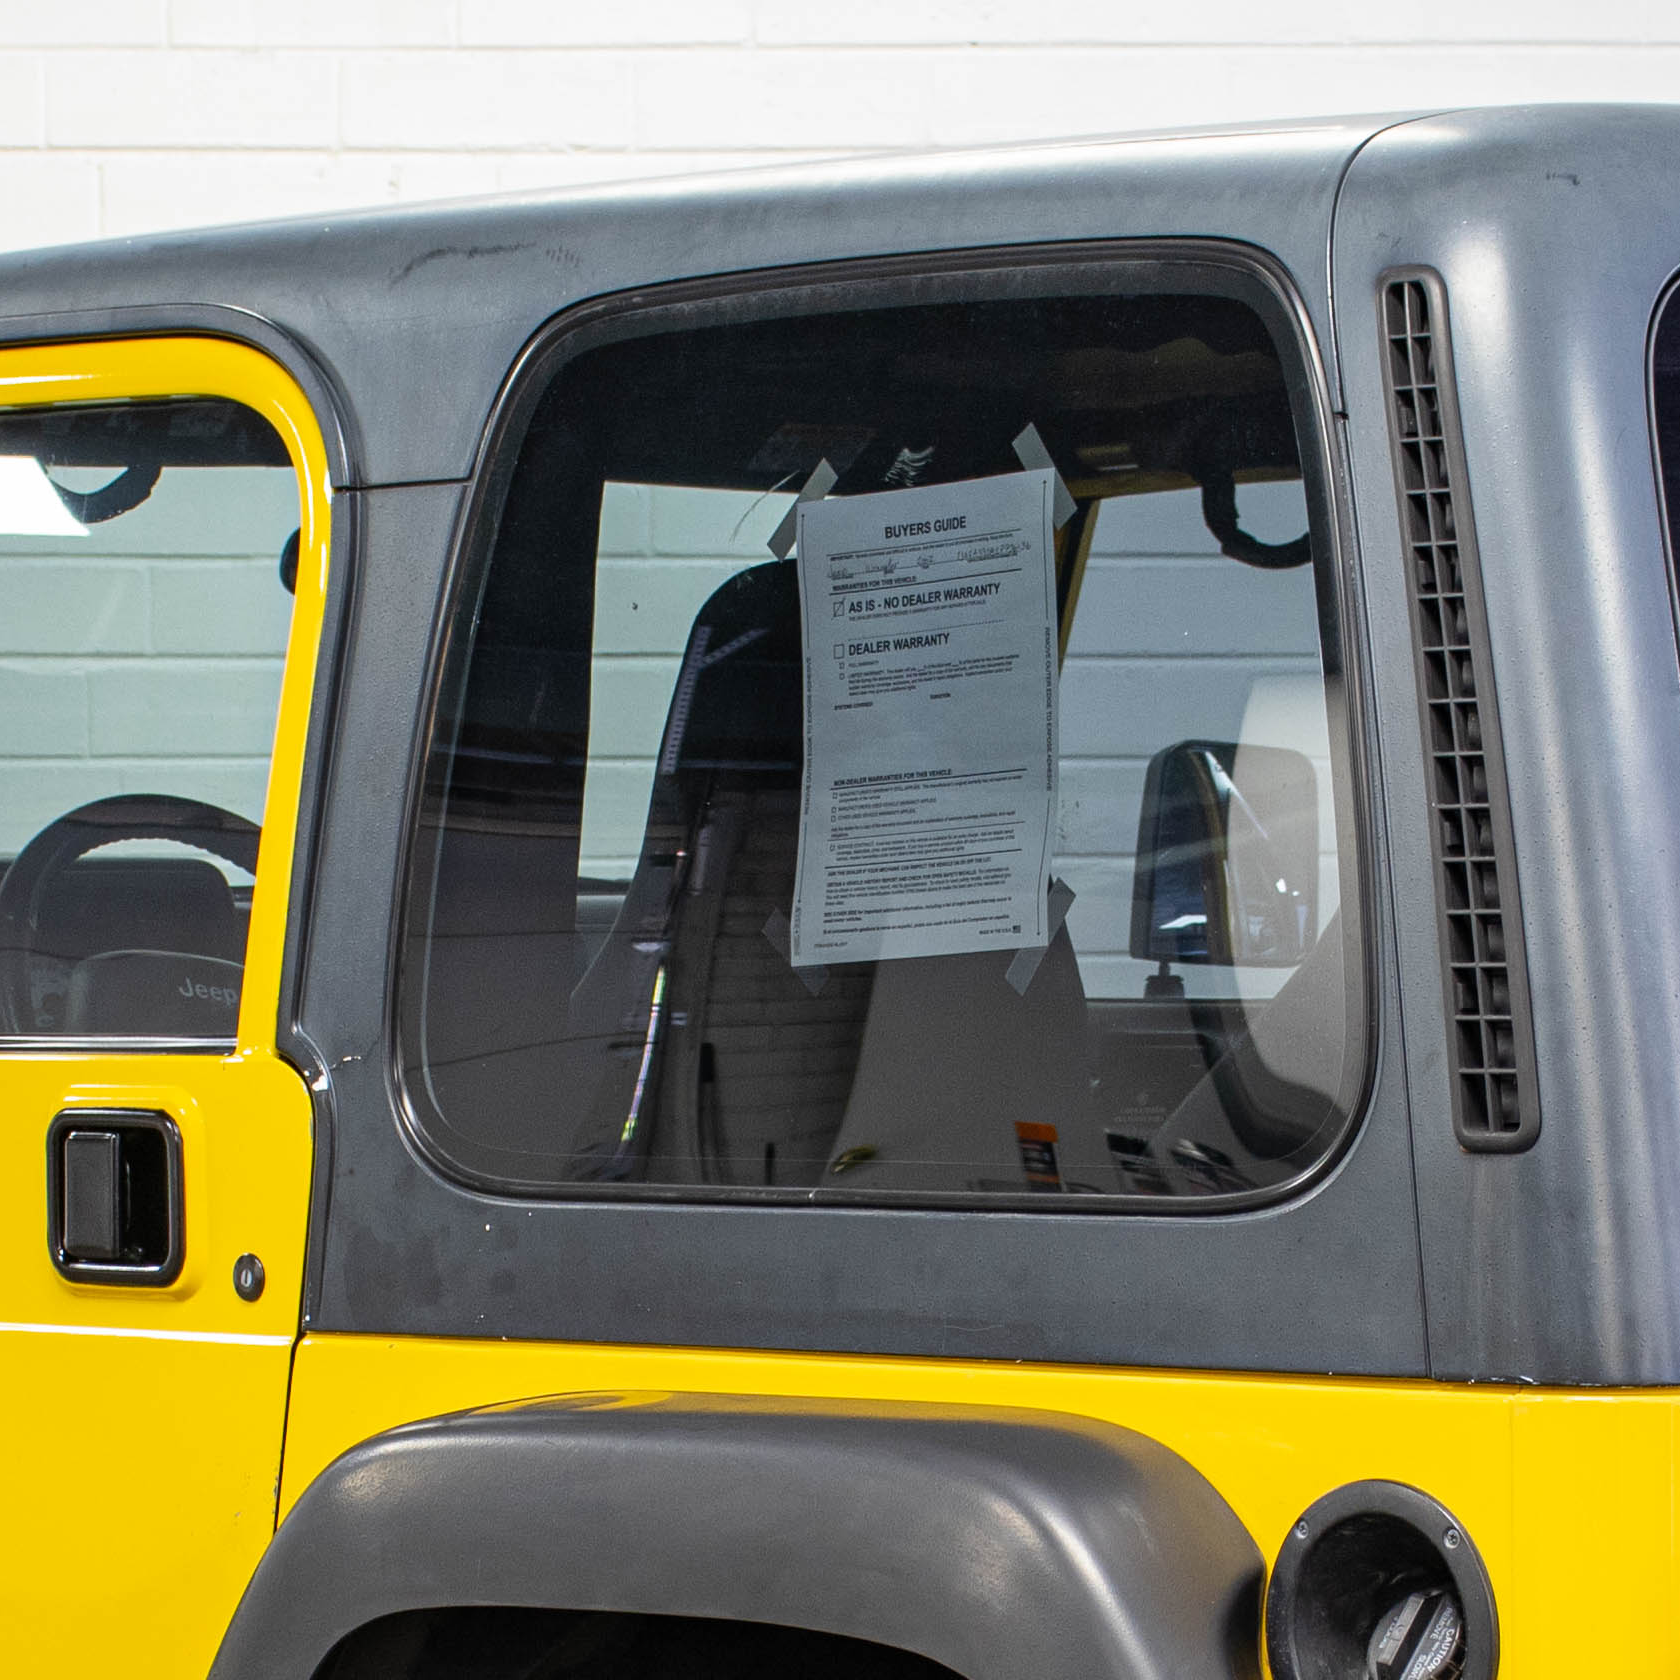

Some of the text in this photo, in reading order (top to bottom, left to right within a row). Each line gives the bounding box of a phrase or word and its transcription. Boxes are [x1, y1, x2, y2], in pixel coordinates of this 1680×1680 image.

[884, 516, 967, 539] BUYERS GUIDE
[848, 599, 862, 614] AS
[865, 598, 875, 612] IS
[883, 595, 900, 610] NO
[902, 590, 941, 607] DEALER
[943, 582, 1001, 601] WARRANTY
[848, 632, 950, 657] DEALER WARRANTY
[176, 975, 239, 1008] Jeep
[1429, 1606, 1454, 1641] REMOVE
[1426, 1627, 1456, 1673] CAUTION
